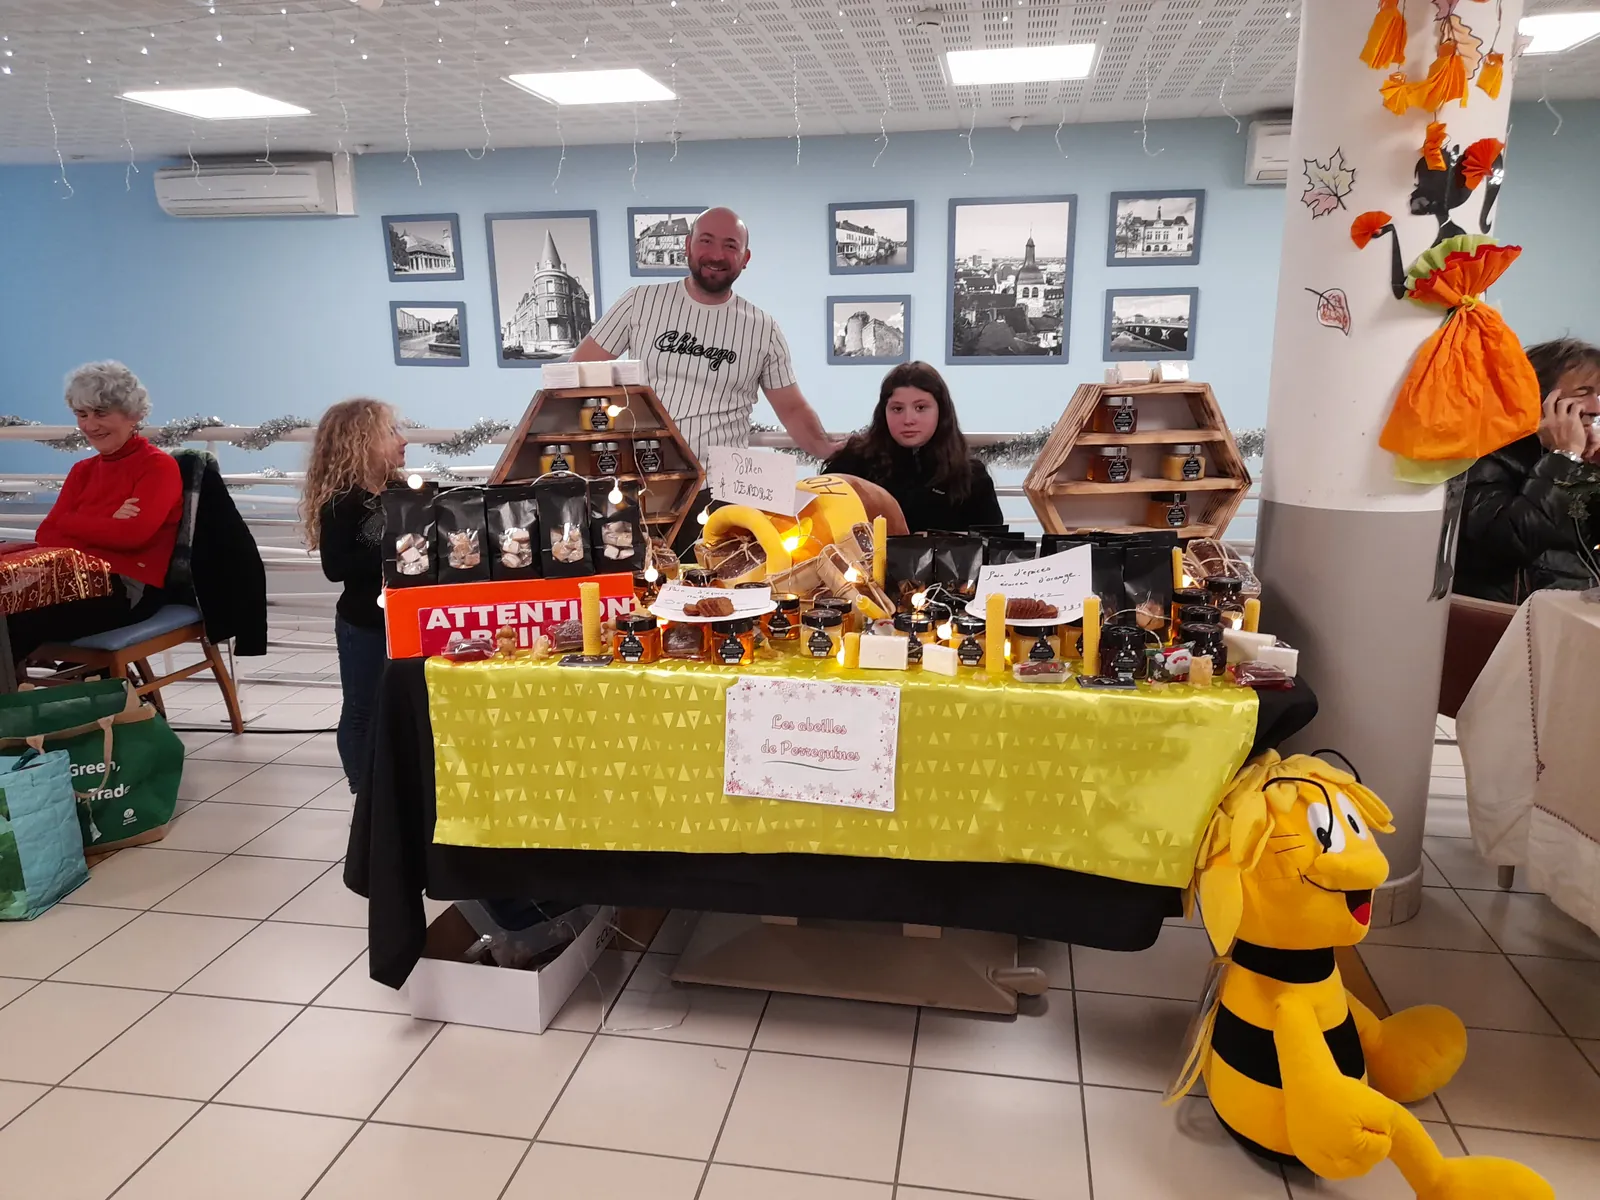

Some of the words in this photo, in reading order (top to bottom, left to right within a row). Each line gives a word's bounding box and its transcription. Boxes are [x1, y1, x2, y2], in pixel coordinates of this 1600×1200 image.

[654, 331, 737, 371] Chicago
[771, 713, 796, 731] Les
[797, 716, 848, 735] abeilles
[760, 738, 777, 754] de
